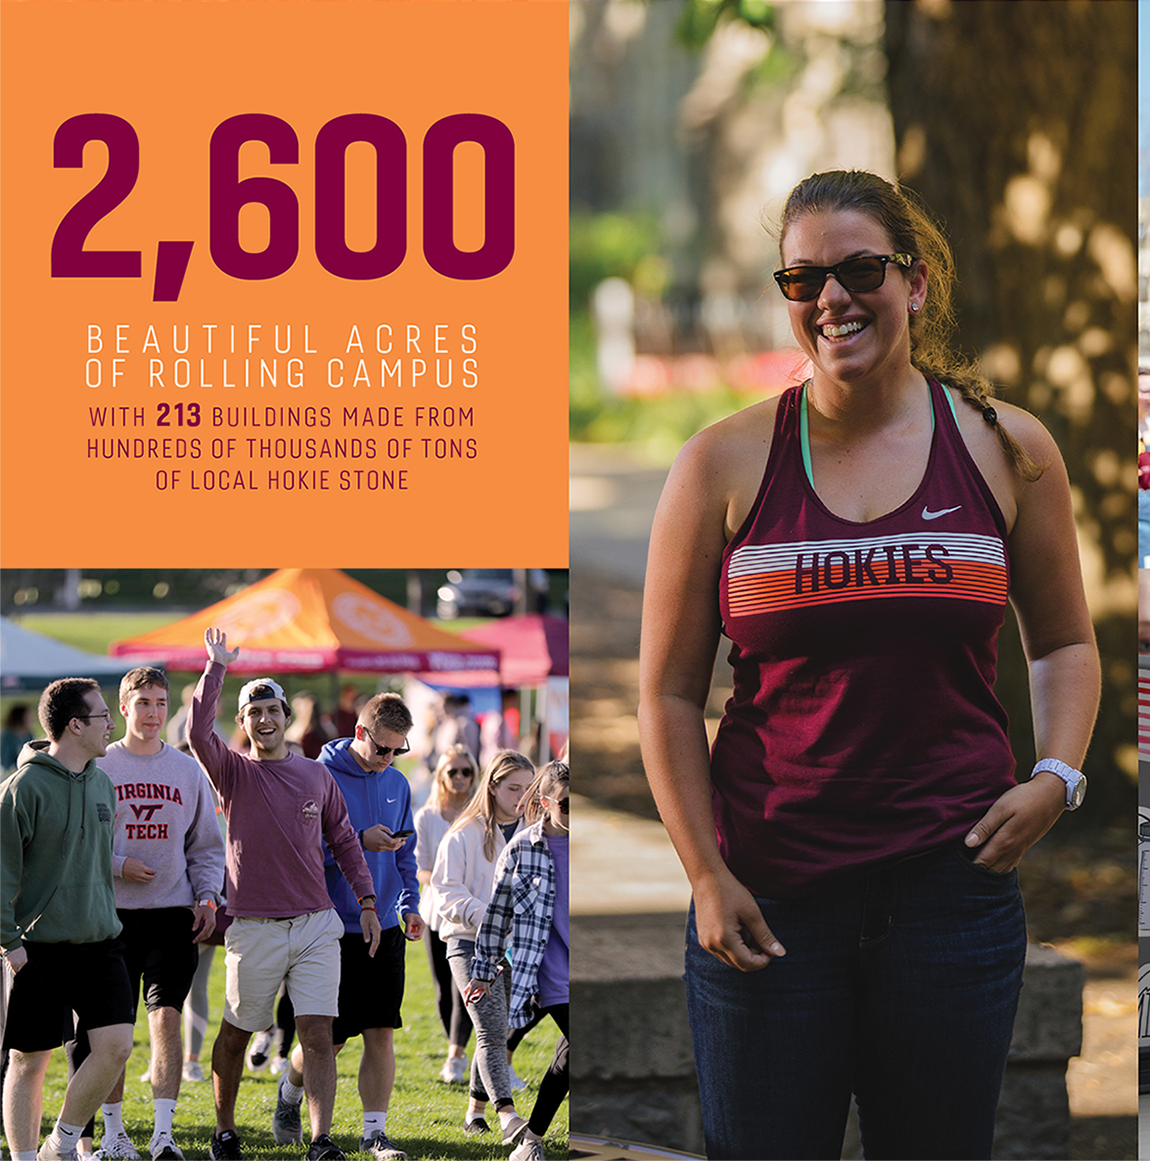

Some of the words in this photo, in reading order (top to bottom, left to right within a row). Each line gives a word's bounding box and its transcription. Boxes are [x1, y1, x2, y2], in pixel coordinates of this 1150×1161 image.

[794, 543, 954, 595] HOKIES
[114, 782, 183, 806] IRGINIA
[129, 803, 164, 822] VT
[125, 823, 169, 840] TECH
